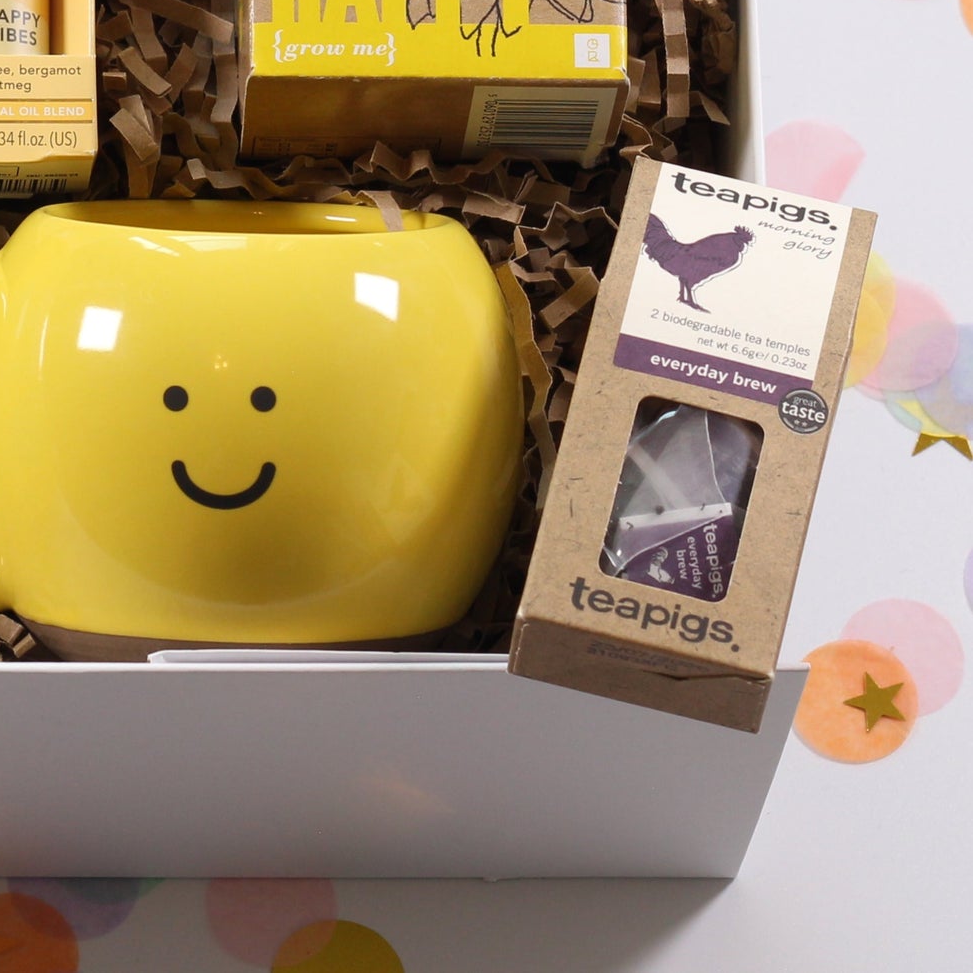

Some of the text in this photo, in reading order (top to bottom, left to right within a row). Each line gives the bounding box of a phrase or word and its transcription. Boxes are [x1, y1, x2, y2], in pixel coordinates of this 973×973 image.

[19, 64, 81, 77] bergamot
[19, 105, 40, 116] OIL
[43, 106, 85, 116] BLEND
[17, 131, 47, 147] fl.oz.
[49, 131, 77, 148] (US)
[671, 171, 838, 231] teapigs.
[757, 218, 836, 245] morning
[782, 239, 833, 260] glory
[650, 308, 811, 357] 2 biodegradable tea temples
[697, 336, 713, 347] net
[716, 342, 728, 351] wt
[771, 353, 808, 371] 0.23oz
[650, 354, 777, 394] everyday brew
[782, 401, 825, 423] taste
[792, 396, 817, 408] great
[676, 549, 688, 579] brew
[687, 536, 703, 590] everyday
[703, 523, 724, 599] teapigs.
[569, 577, 740, 653] teapigs.
